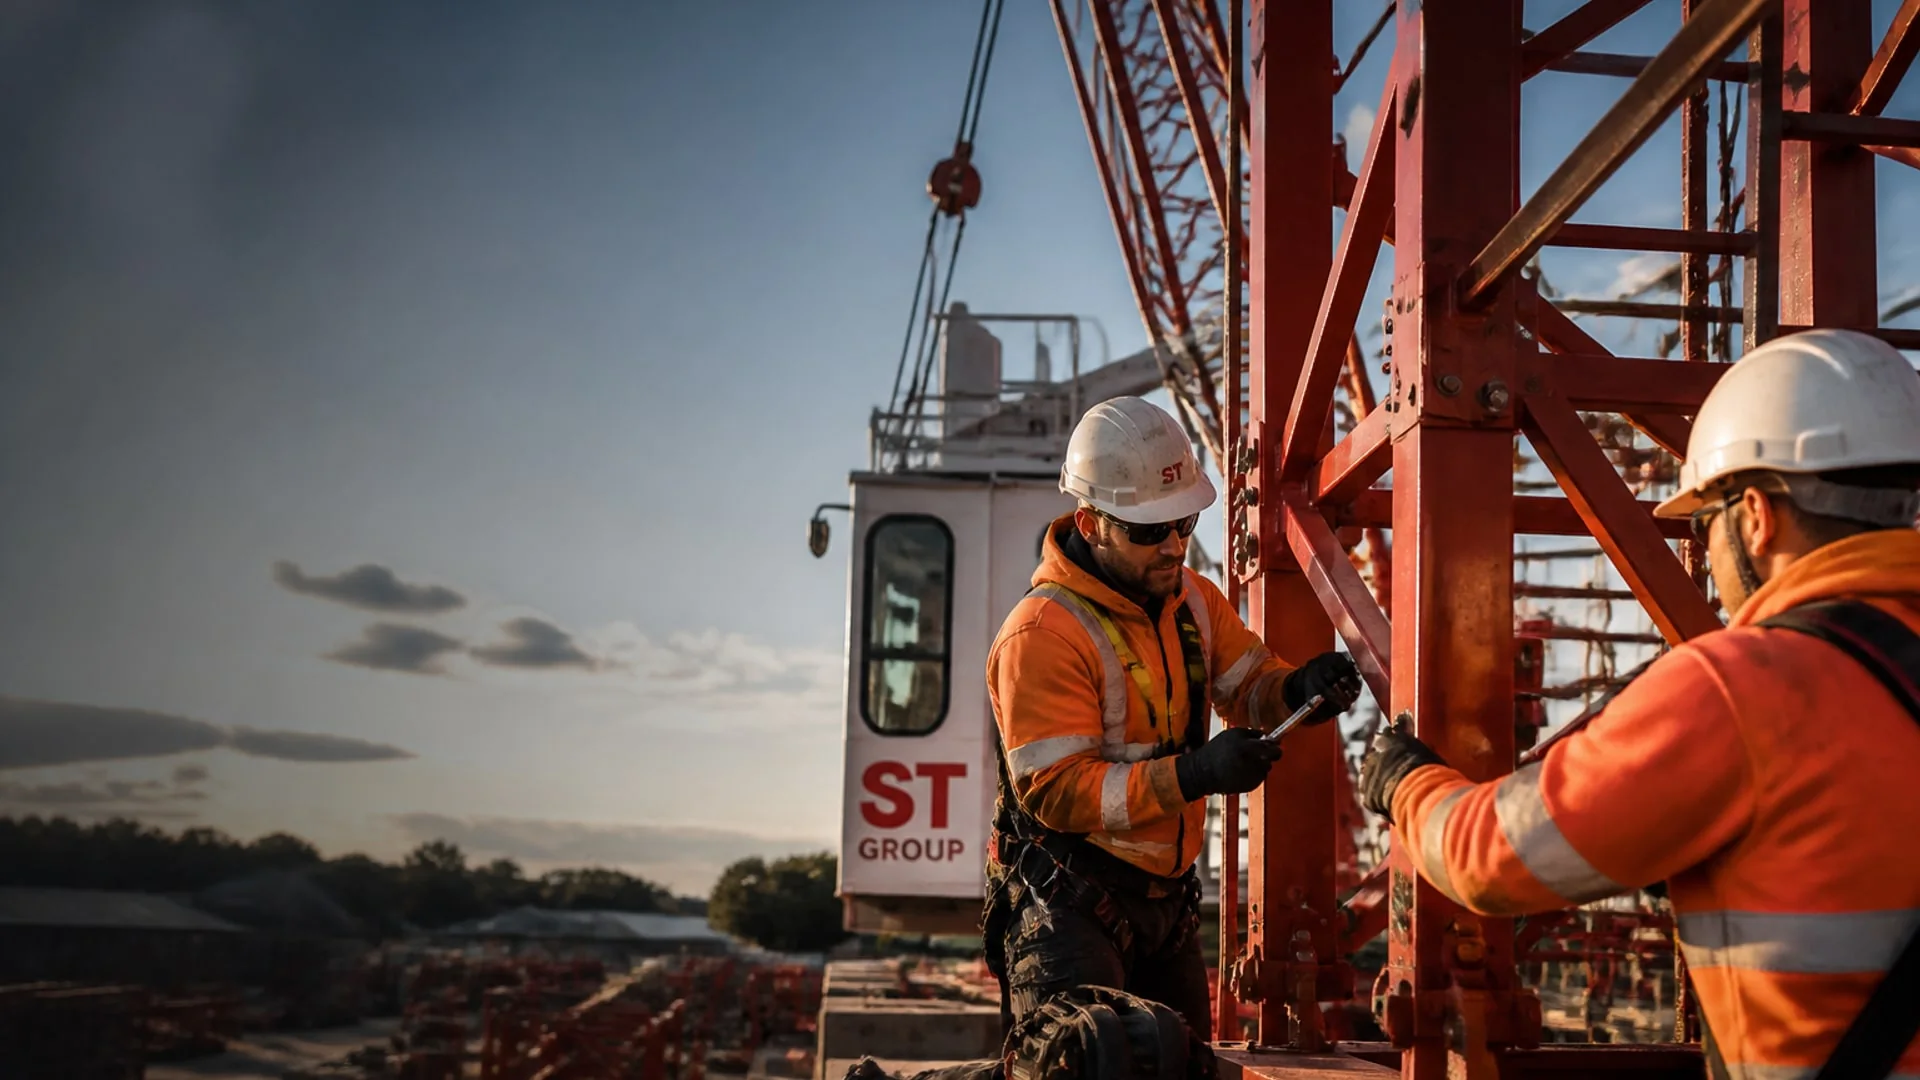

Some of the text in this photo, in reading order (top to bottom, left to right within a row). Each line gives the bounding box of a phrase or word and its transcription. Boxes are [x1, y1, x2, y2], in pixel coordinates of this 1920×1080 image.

[1162, 462, 1183, 485] ST
[860, 760, 967, 829] ST
[858, 837, 965, 862] GROUP
